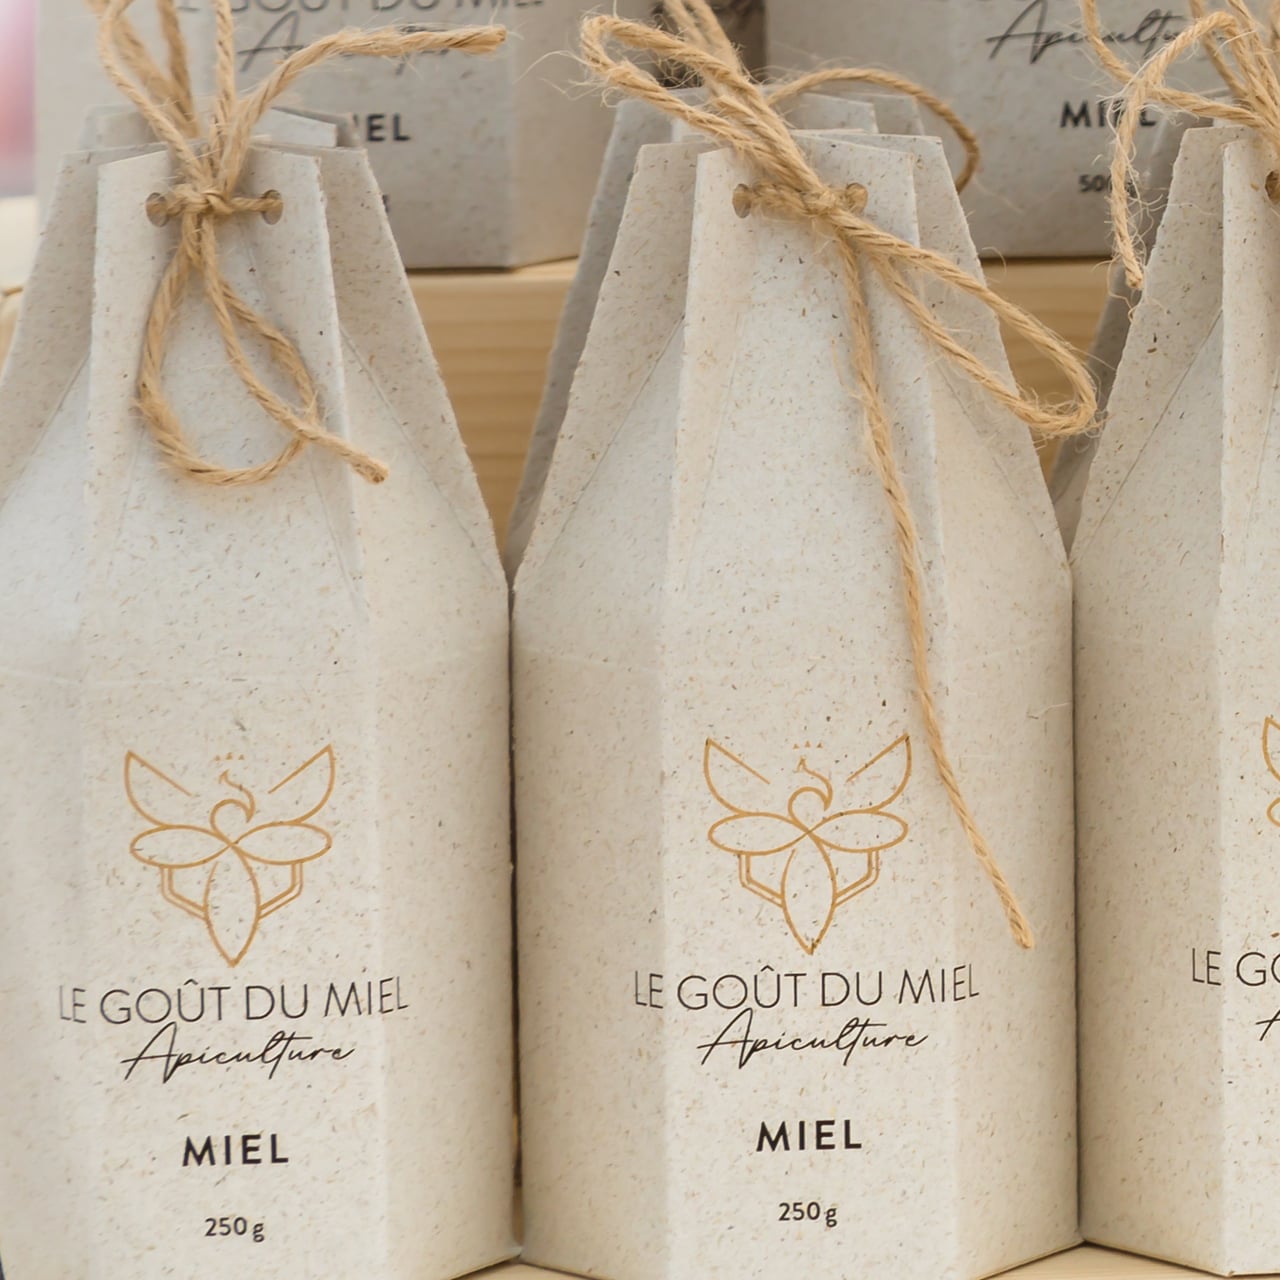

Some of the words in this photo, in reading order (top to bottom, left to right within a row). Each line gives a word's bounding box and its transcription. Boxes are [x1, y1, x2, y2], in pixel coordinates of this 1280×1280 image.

[634, 970, 664, 1010] LE
[677, 965, 807, 1011] GOÛT
[821, 970, 883, 1008] DU
[898, 963, 980, 1005] MIEL
[1191, 947, 1222, 986] LE
[58, 984, 87, 1024] LE
[99, 978, 232, 1025] GOÛT
[245, 982, 309, 1021] DU
[323, 975, 408, 1017] MIEL
[120, 1020, 356, 1084] Apiculture
[696, 1007, 928, 1070] Apiculture
[182, 1133, 289, 1167] MIEL
[756, 1119, 862, 1152] MIEL
